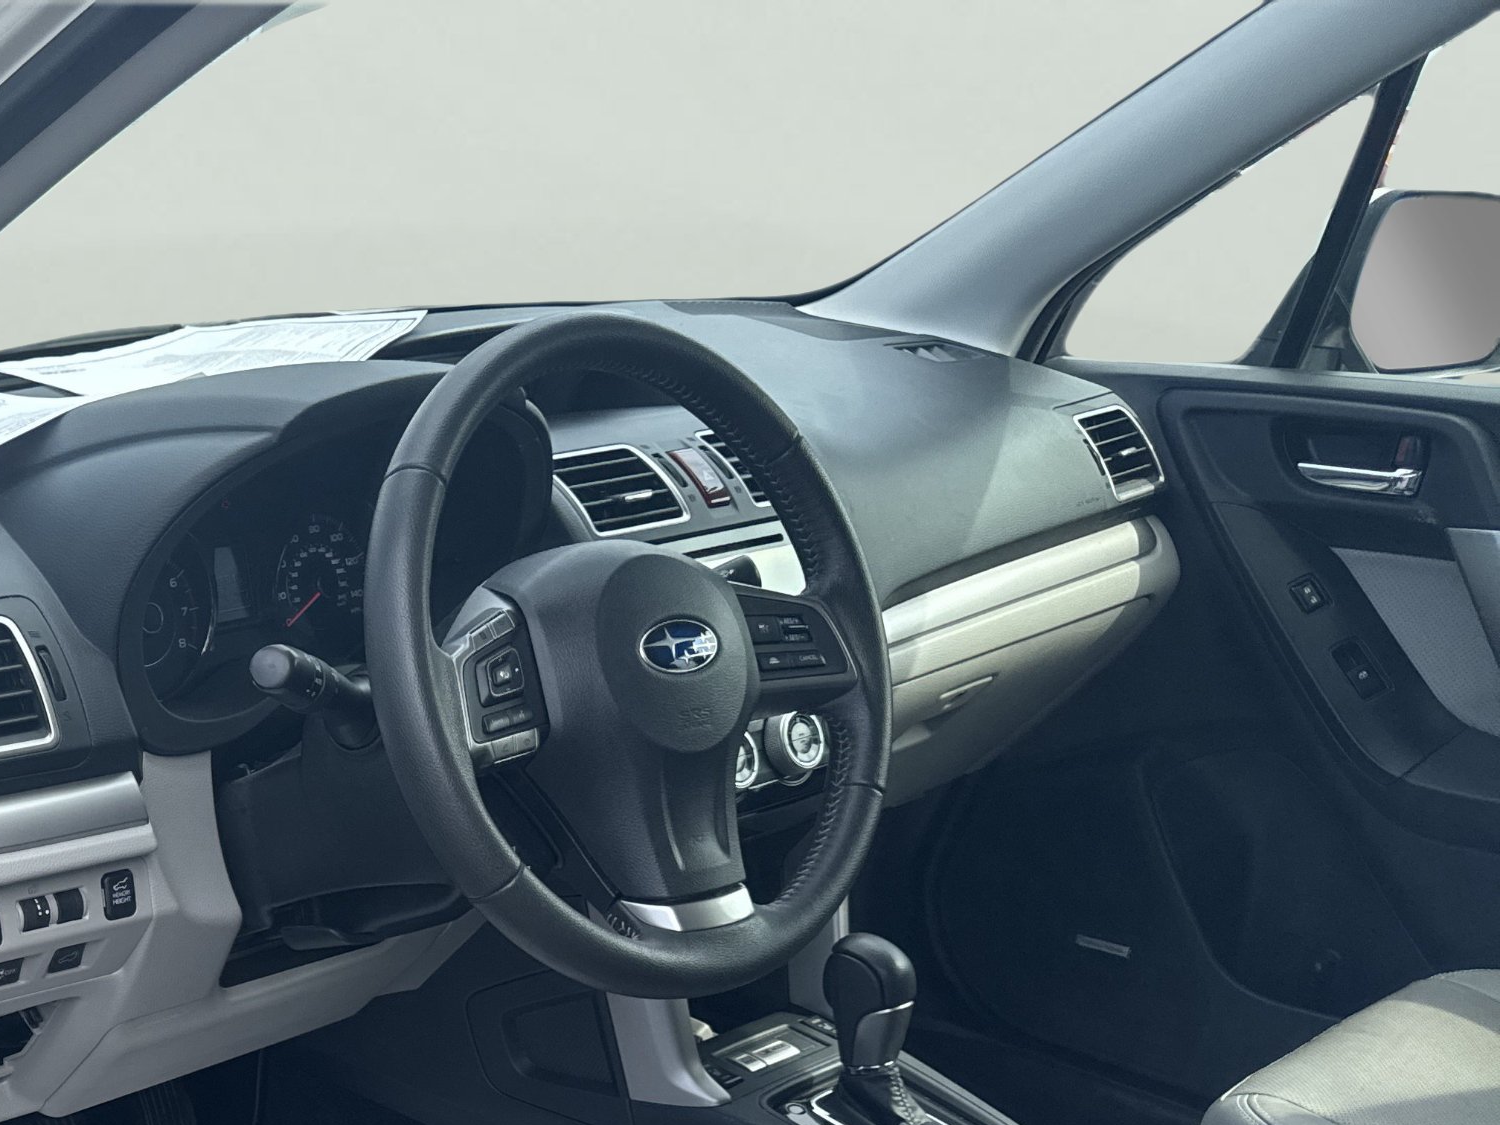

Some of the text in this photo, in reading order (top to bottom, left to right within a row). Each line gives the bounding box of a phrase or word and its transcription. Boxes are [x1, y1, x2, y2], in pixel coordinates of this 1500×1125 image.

[308, 524, 321, 533] 80
[330, 533, 343, 542] 100
[169, 577, 178, 588] 6
[180, 606, 188, 616] 7
[178, 638, 186, 648] 8
